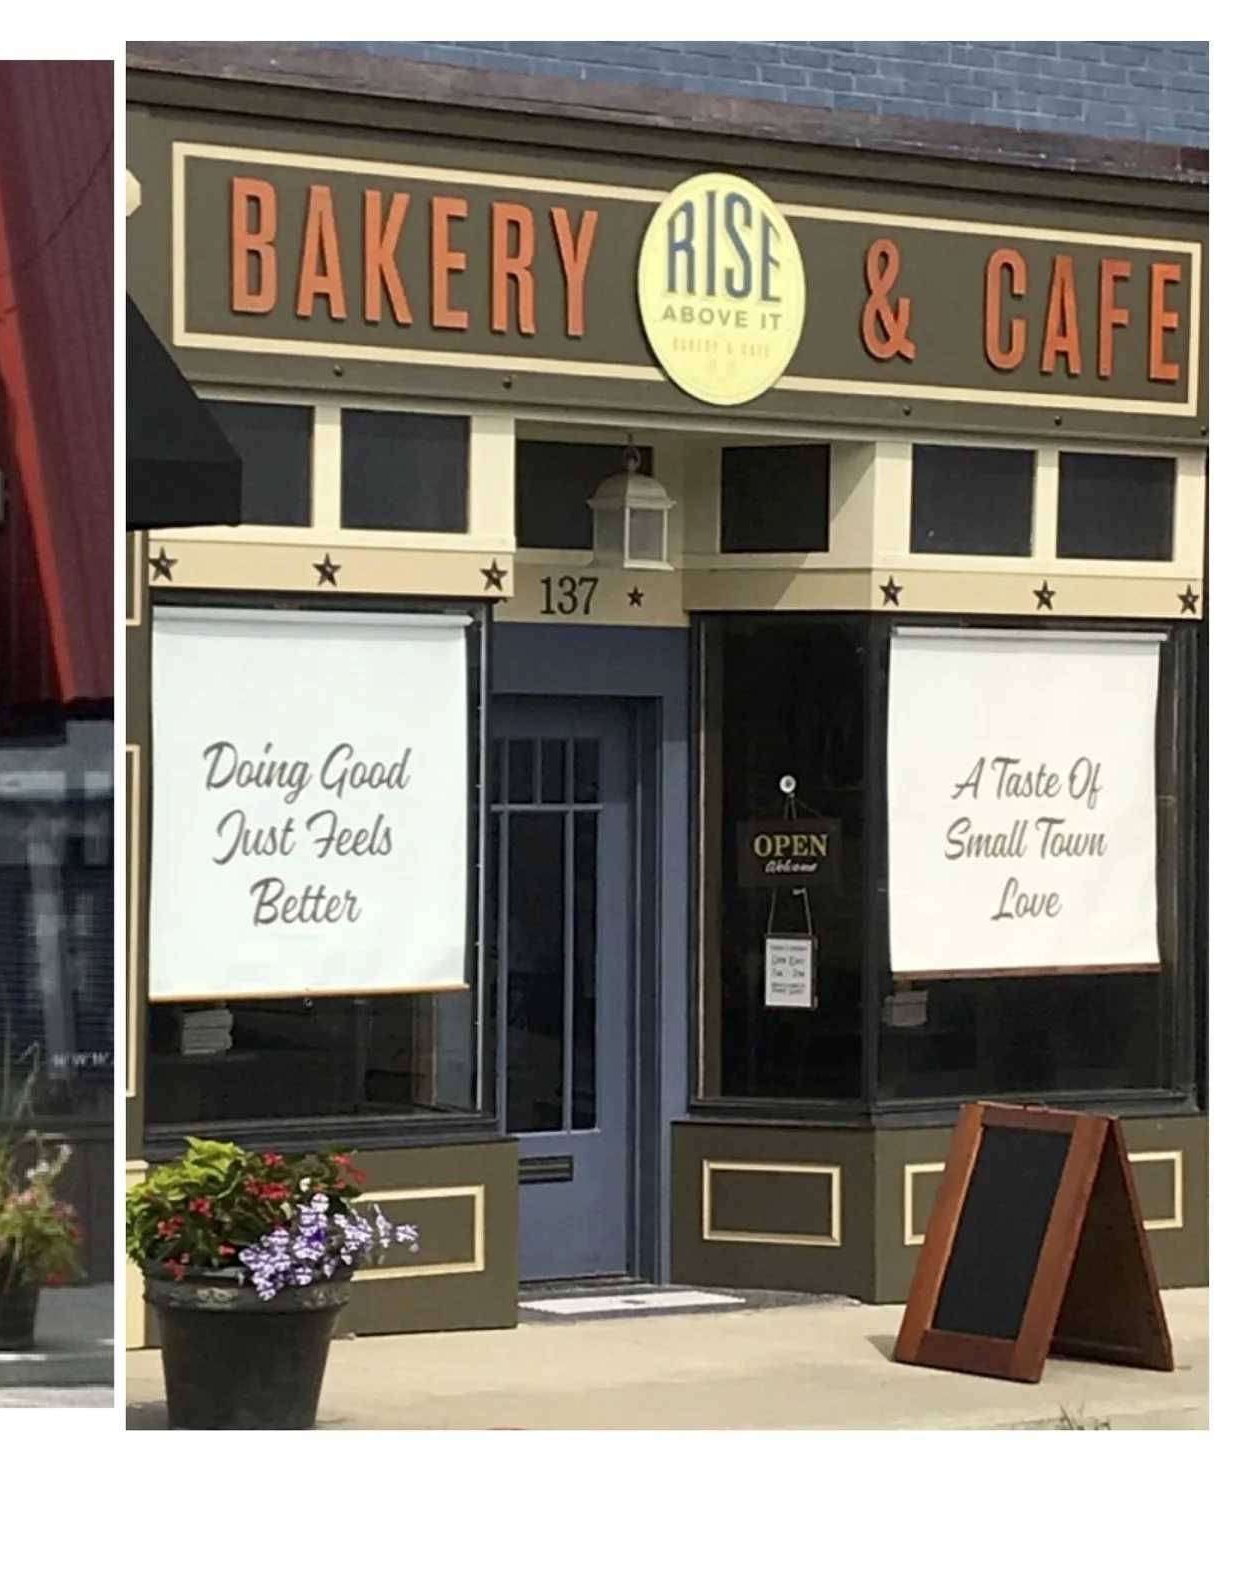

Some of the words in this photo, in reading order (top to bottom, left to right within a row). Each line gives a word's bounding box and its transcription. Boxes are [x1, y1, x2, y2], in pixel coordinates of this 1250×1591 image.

[667, 190, 782, 304] RISE
[231, 176, 599, 339] BAKERY
[861, 238, 915, 361] &
[985, 248, 1182, 382] CAFE
[662, 305, 748, 328] ABOVE
[760, 313, 782, 330] IT
[539, 575, 599, 615] 137
[202, 741, 313, 804] Doing
[320, 743, 412, 799] Good
[950, 756, 986, 800] A
[991, 756, 1062, 800] Taste
[1068, 756, 1103, 810] Of
[212, 809, 296, 865] Just
[305, 809, 392, 858] Feels
[753, 834, 828, 857] OPEN
[944, 816, 1028, 860] Small
[1034, 816, 1109, 859] Town
[249, 876, 362, 926] Better
[990, 876, 1062, 921] Love
